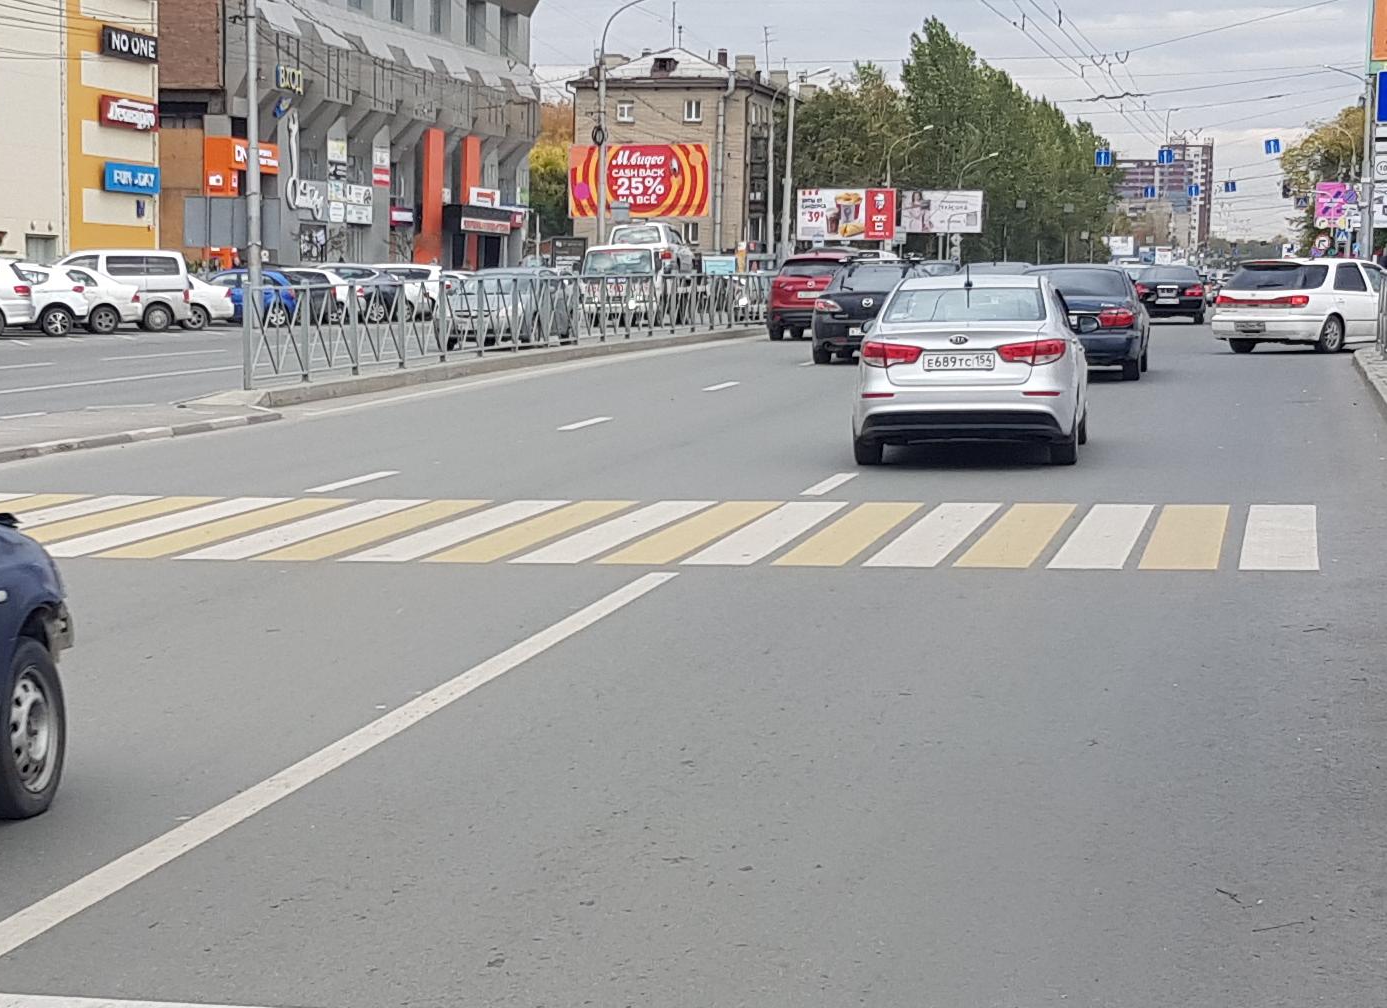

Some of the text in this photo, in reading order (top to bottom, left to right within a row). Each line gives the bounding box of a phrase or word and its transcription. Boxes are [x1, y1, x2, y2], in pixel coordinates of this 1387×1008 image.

[111, 31, 156, 58] NO ONE
[279, 65, 303, 95] ВХОД
[612, 168, 665, 178] CASH BACK
